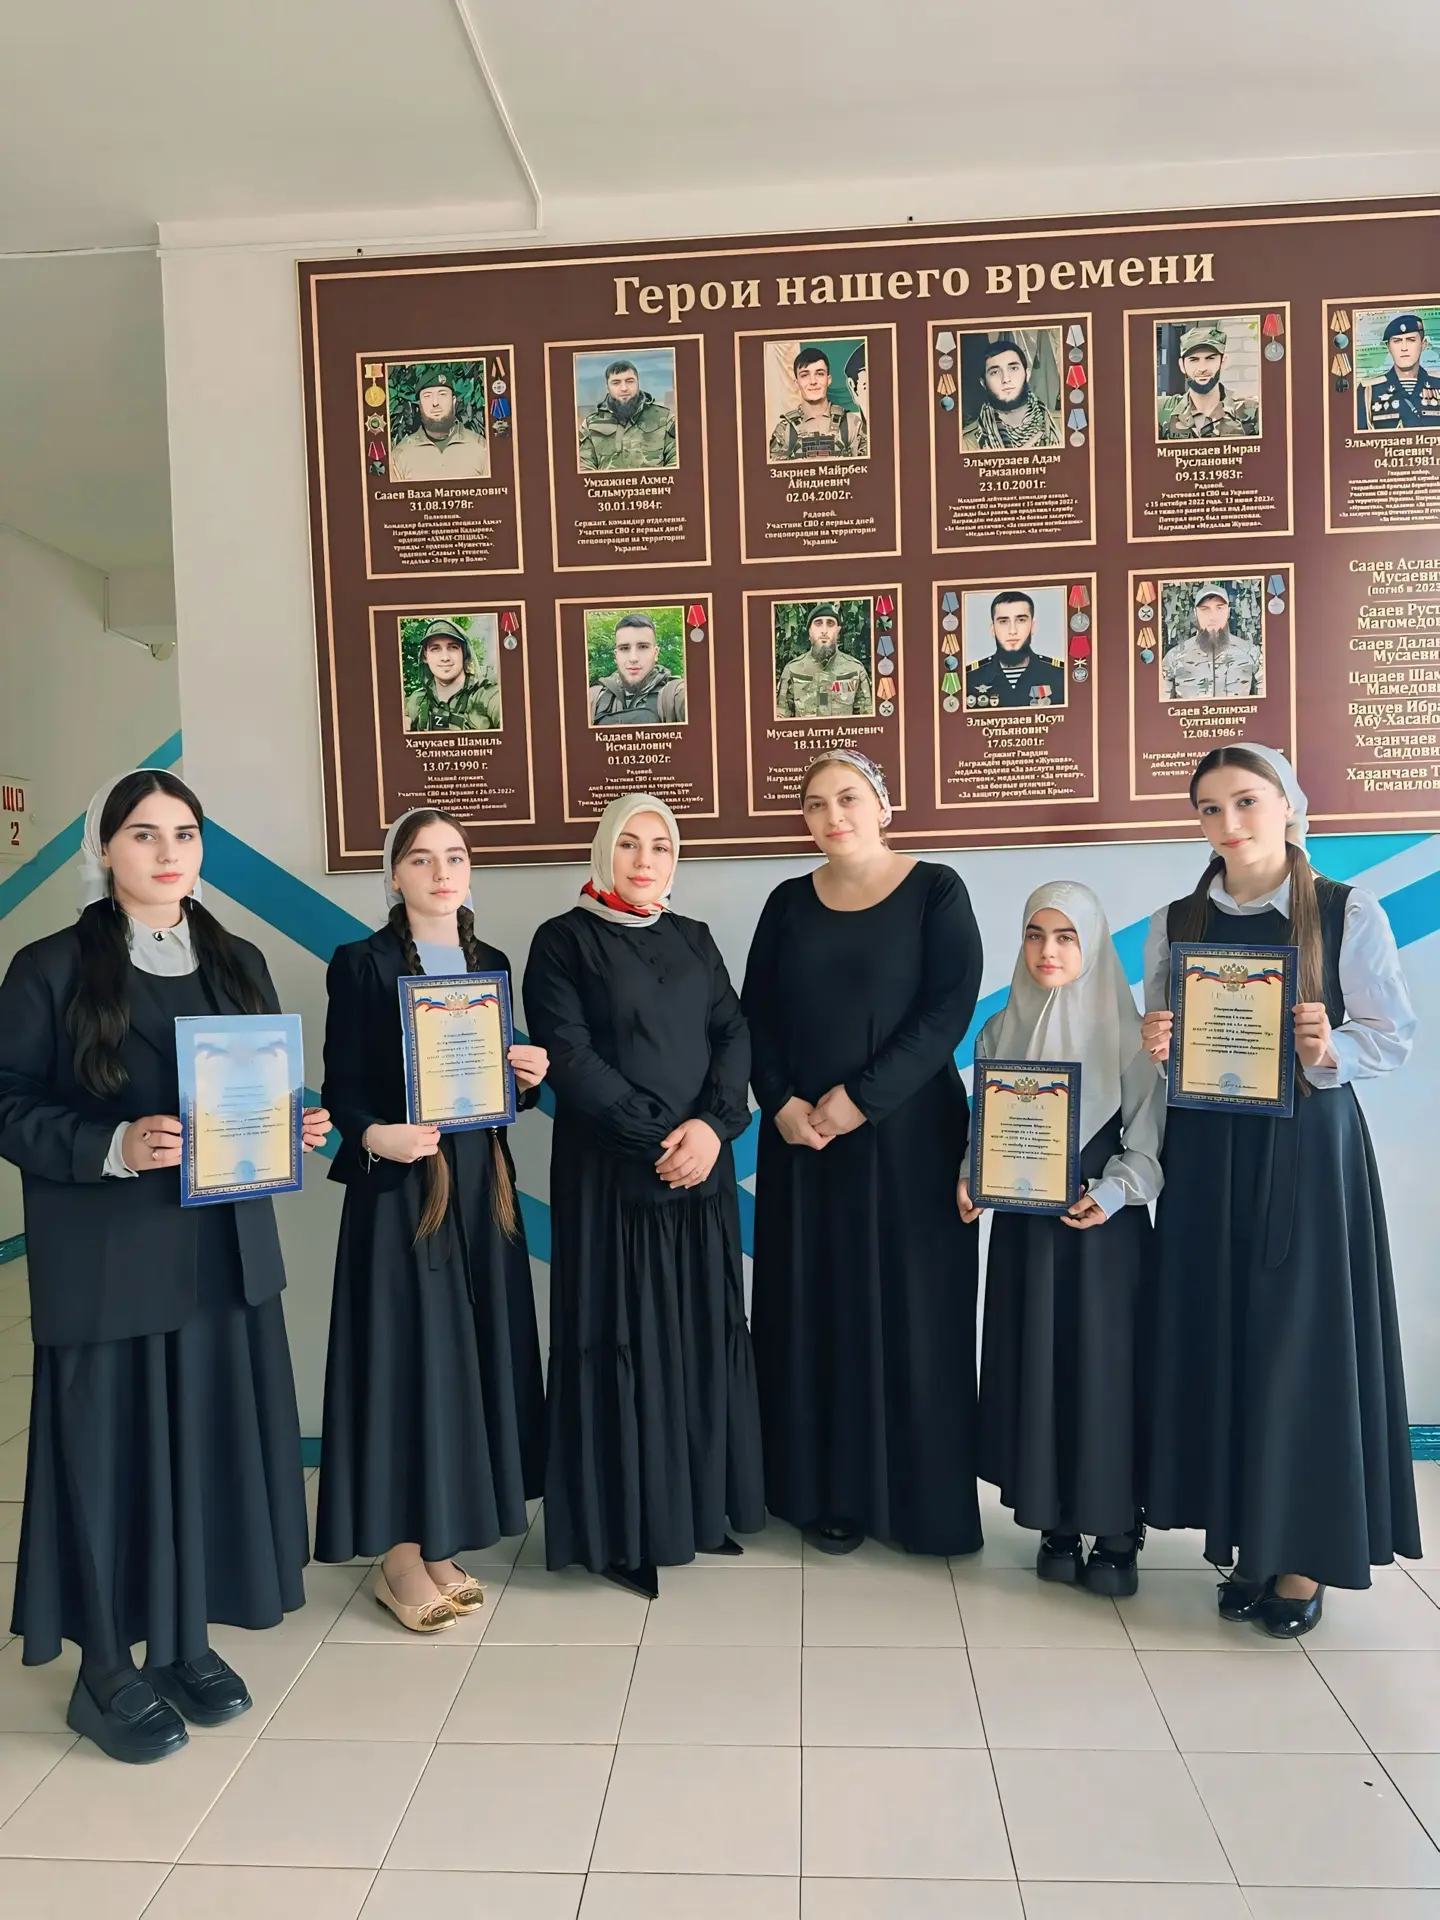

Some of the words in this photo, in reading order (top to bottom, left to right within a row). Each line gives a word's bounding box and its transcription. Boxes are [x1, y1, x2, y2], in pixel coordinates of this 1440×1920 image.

[613, 276, 762, 324] Герои
[775, 267, 970, 306] нашего
[984, 253, 1215, 304] времени
[1345, 438, 1413, 449] Эльмурзаев
[1157, 448, 1220, 459] Мирискаев
[1223, 445, 1260, 456] Имран
[1384, 448, 1432, 457] Исаевич
[964, 457, 1029, 467] Эльмурзаев
[1032, 454, 1060, 464] Адам
[1176, 457, 1242, 469] Русланович
[770, 469, 816, 479] Закриев
[819, 465, 868, 476] Майрбек
[979, 467, 1046, 477] Рамзанович
[1175, 470, 1243, 481] 09.13.1983г.
[584, 478, 638, 487] Умхажиев
[640, 476, 674, 485] Ахмед
[788, 478, 850, 488] Айндиевич
[979, 480, 1046, 491] 23.10.2001г.
[374, 491, 405, 500] Сааев
[407, 490, 432, 499] Ваха
[435, 488, 508, 497] Магомедович
[786, 490, 853, 502] 02.04.2002г.
[410, 500, 474, 511] 31.08.1978г.
[598, 500, 662, 512] 30.01.1984г.
[1349, 560, 1393, 572] Сааев
[1372, 571, 1440, 585] Мусаеви
[1359, 605, 1404, 617] Сааев
[1349, 639, 1393, 651] Сааев
[1349, 672, 1405, 684] Цацаев
[1168, 707, 1200, 716] Сааев
[1202, 706, 1257, 715] Зелимхан
[1348, 703, 1403, 717] Вацуев
[967, 717, 1032, 728] Эльмурзаев
[1035, 714, 1064, 725] Юсуп
[1180, 717, 1246, 728] Султанович
[595, 732, 633, 742] Кадаев
[635, 731, 682, 740] Магомед
[767, 729, 804, 740] Мусаев
[807, 728, 834, 736] Апти
[836, 726, 884, 735] Алиевич
[982, 726, 1049, 738] Супьянович
[1183, 728, 1236, 738] 12.08.1986
[406, 739, 455, 750] Хачукаев
[457, 737, 502, 746] Шамиль
[606, 742, 672, 751] Исмаилович
[794, 738, 857, 750] 18.11.1978г.
[988, 738, 1044, 748] 17.05.2001г.
[1355, 735, 1436, 746] Хазанчаев
[415, 749, 493, 758] Зелимханович
[608, 754, 671, 765] 01.03.2002г.
[423, 761, 479, 771] 13.07.1990
[1346, 768, 1428, 780] Хазанчаев
[11, 821, 20, 846] 2
